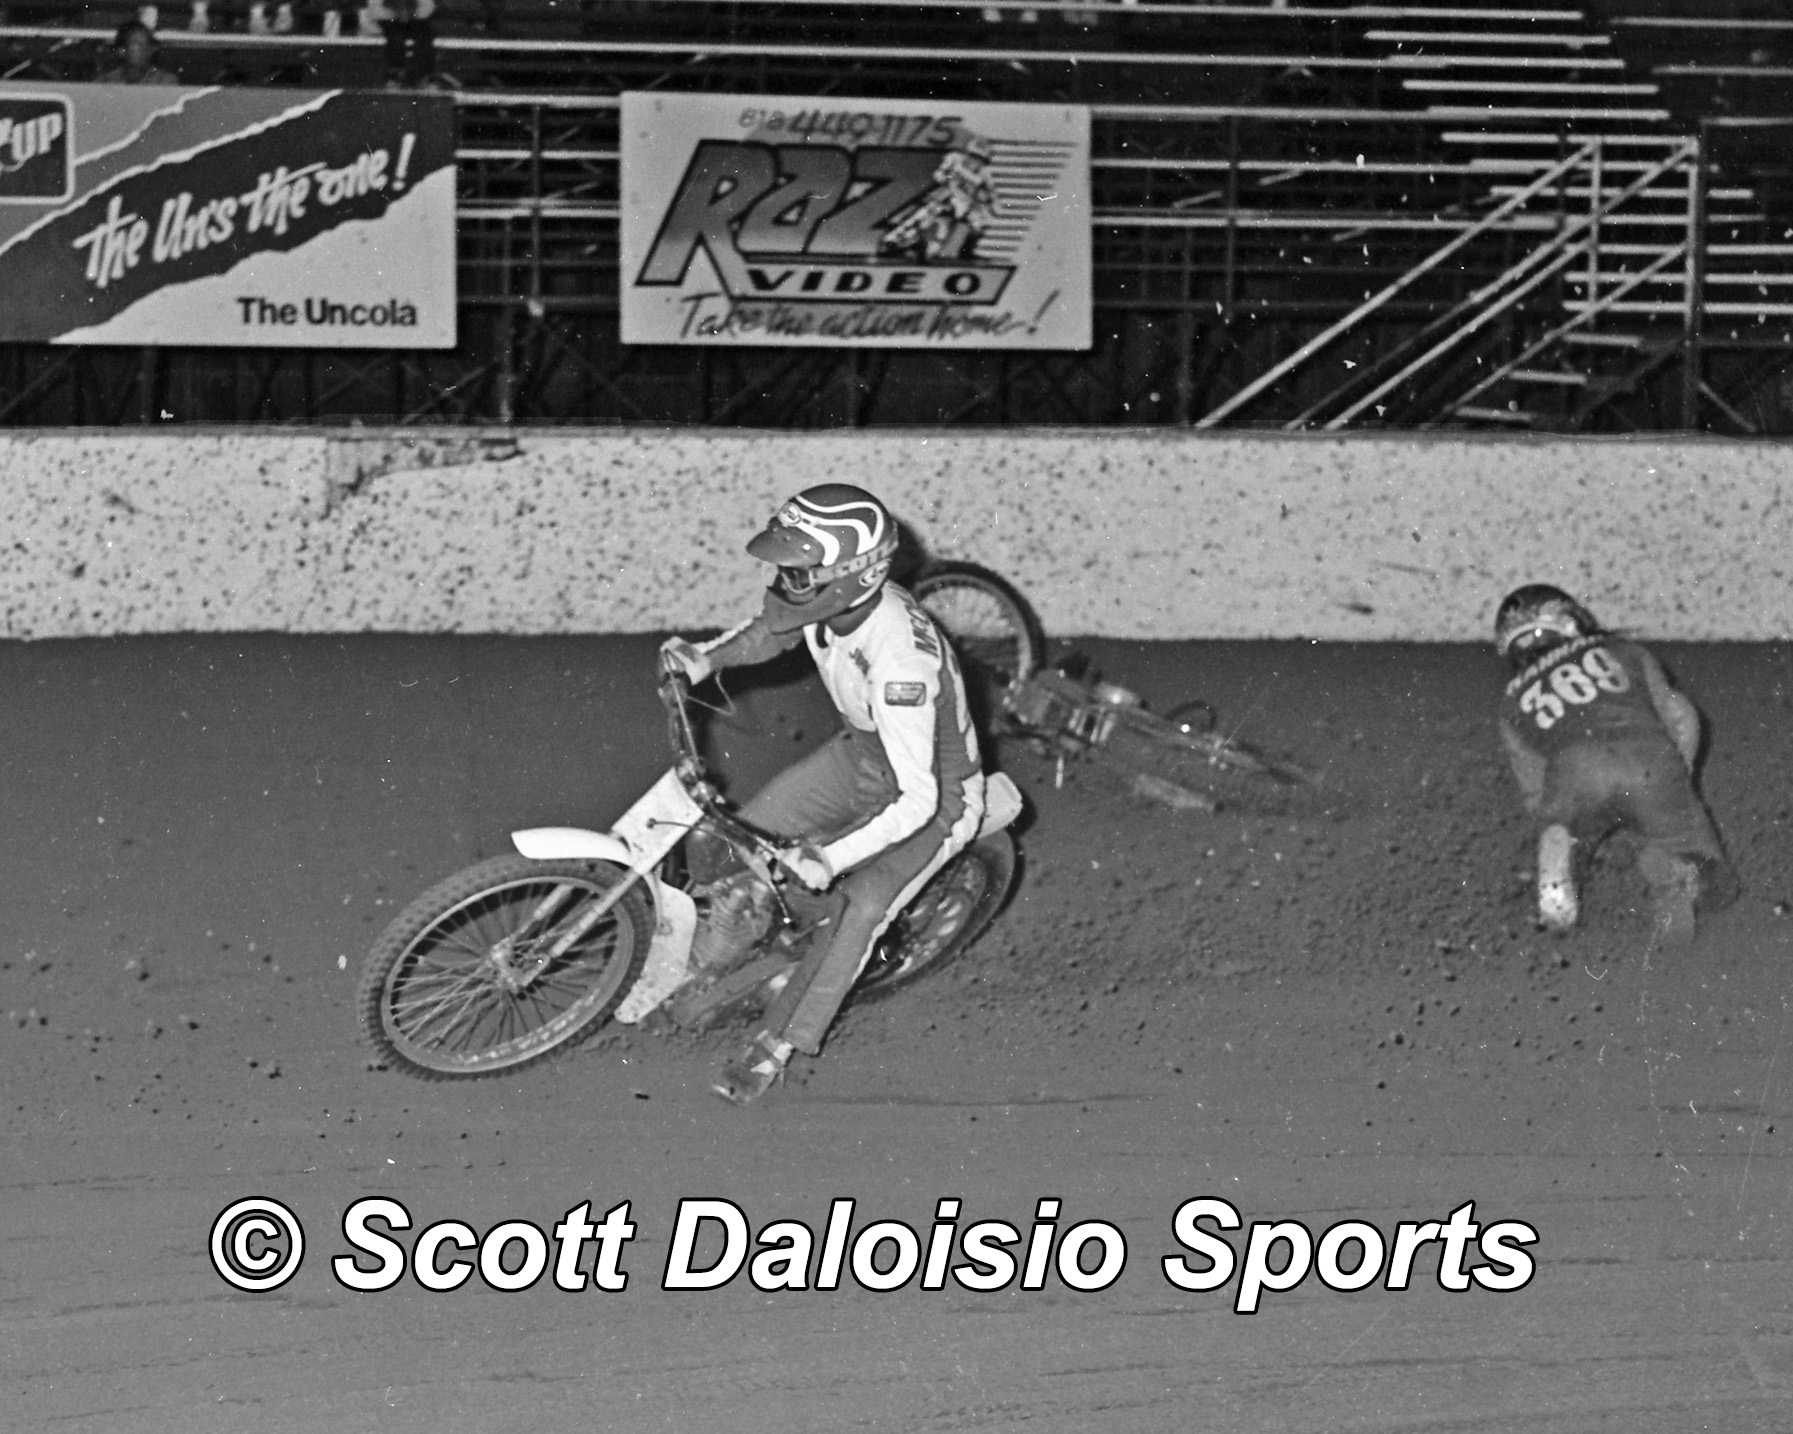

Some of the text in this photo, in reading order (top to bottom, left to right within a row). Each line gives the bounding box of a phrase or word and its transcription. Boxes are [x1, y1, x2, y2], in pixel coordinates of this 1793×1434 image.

[748, 269, 981, 296] VIDEO
[237, 297, 418, 327] The Uncola
[680, 292, 764, 338] Take
